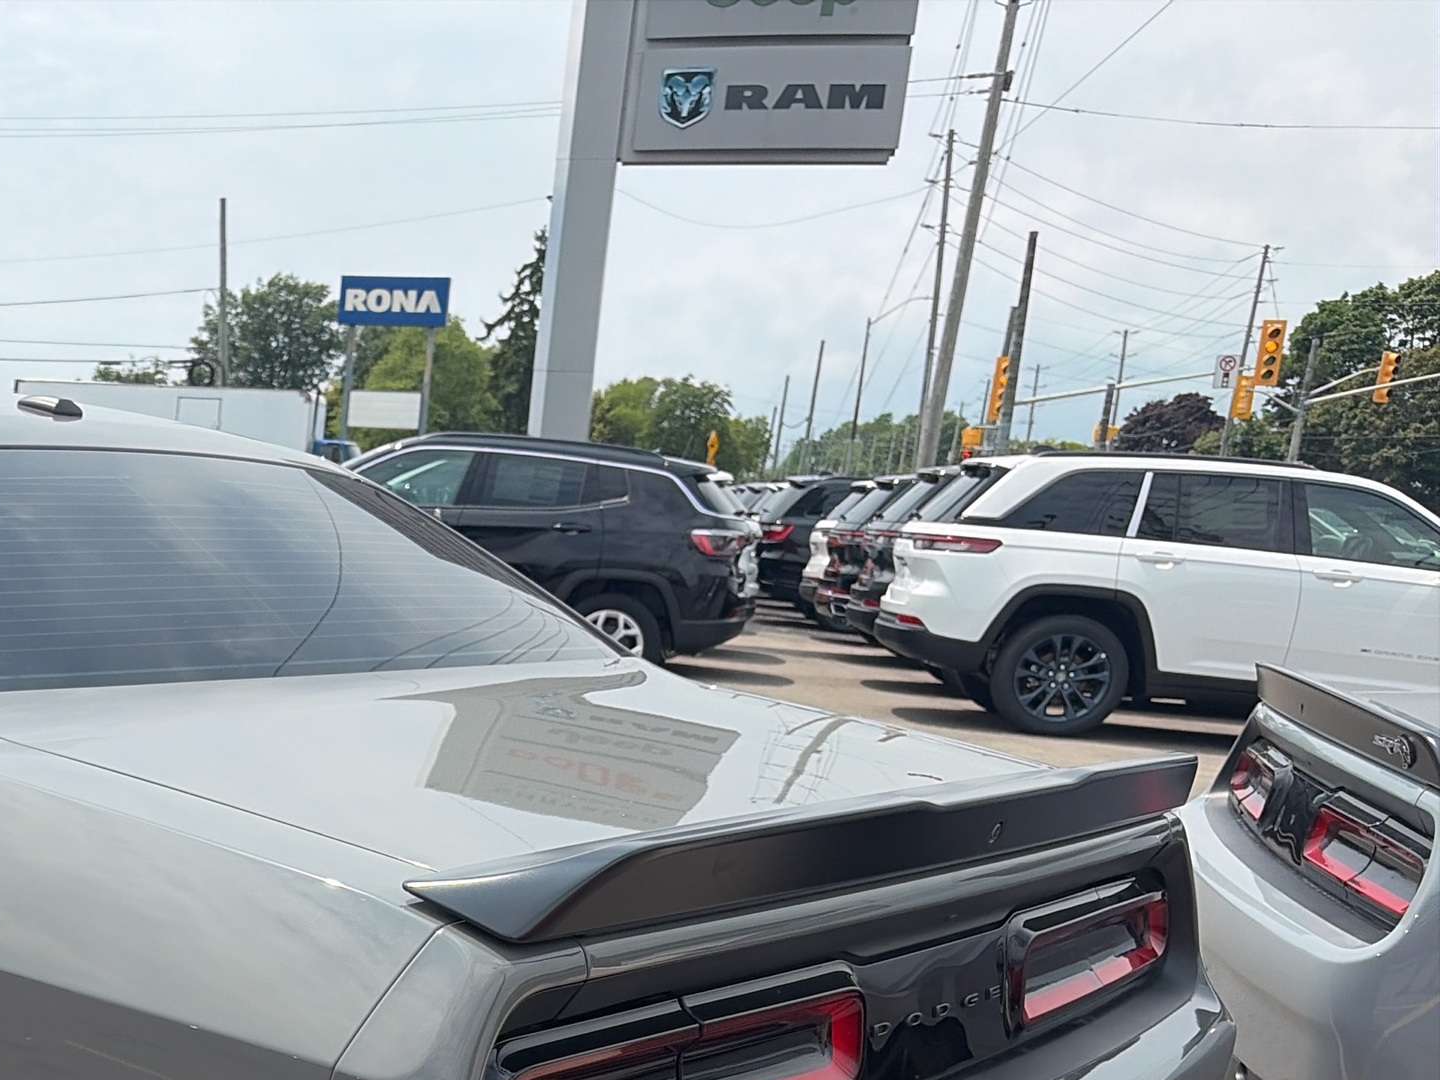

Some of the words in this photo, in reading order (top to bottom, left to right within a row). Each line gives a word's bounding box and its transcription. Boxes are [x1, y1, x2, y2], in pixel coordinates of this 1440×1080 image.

[724, 84, 887, 110] RAM
[344, 288, 442, 314] RONA
[870, 984, 1001, 1037] DODGE
